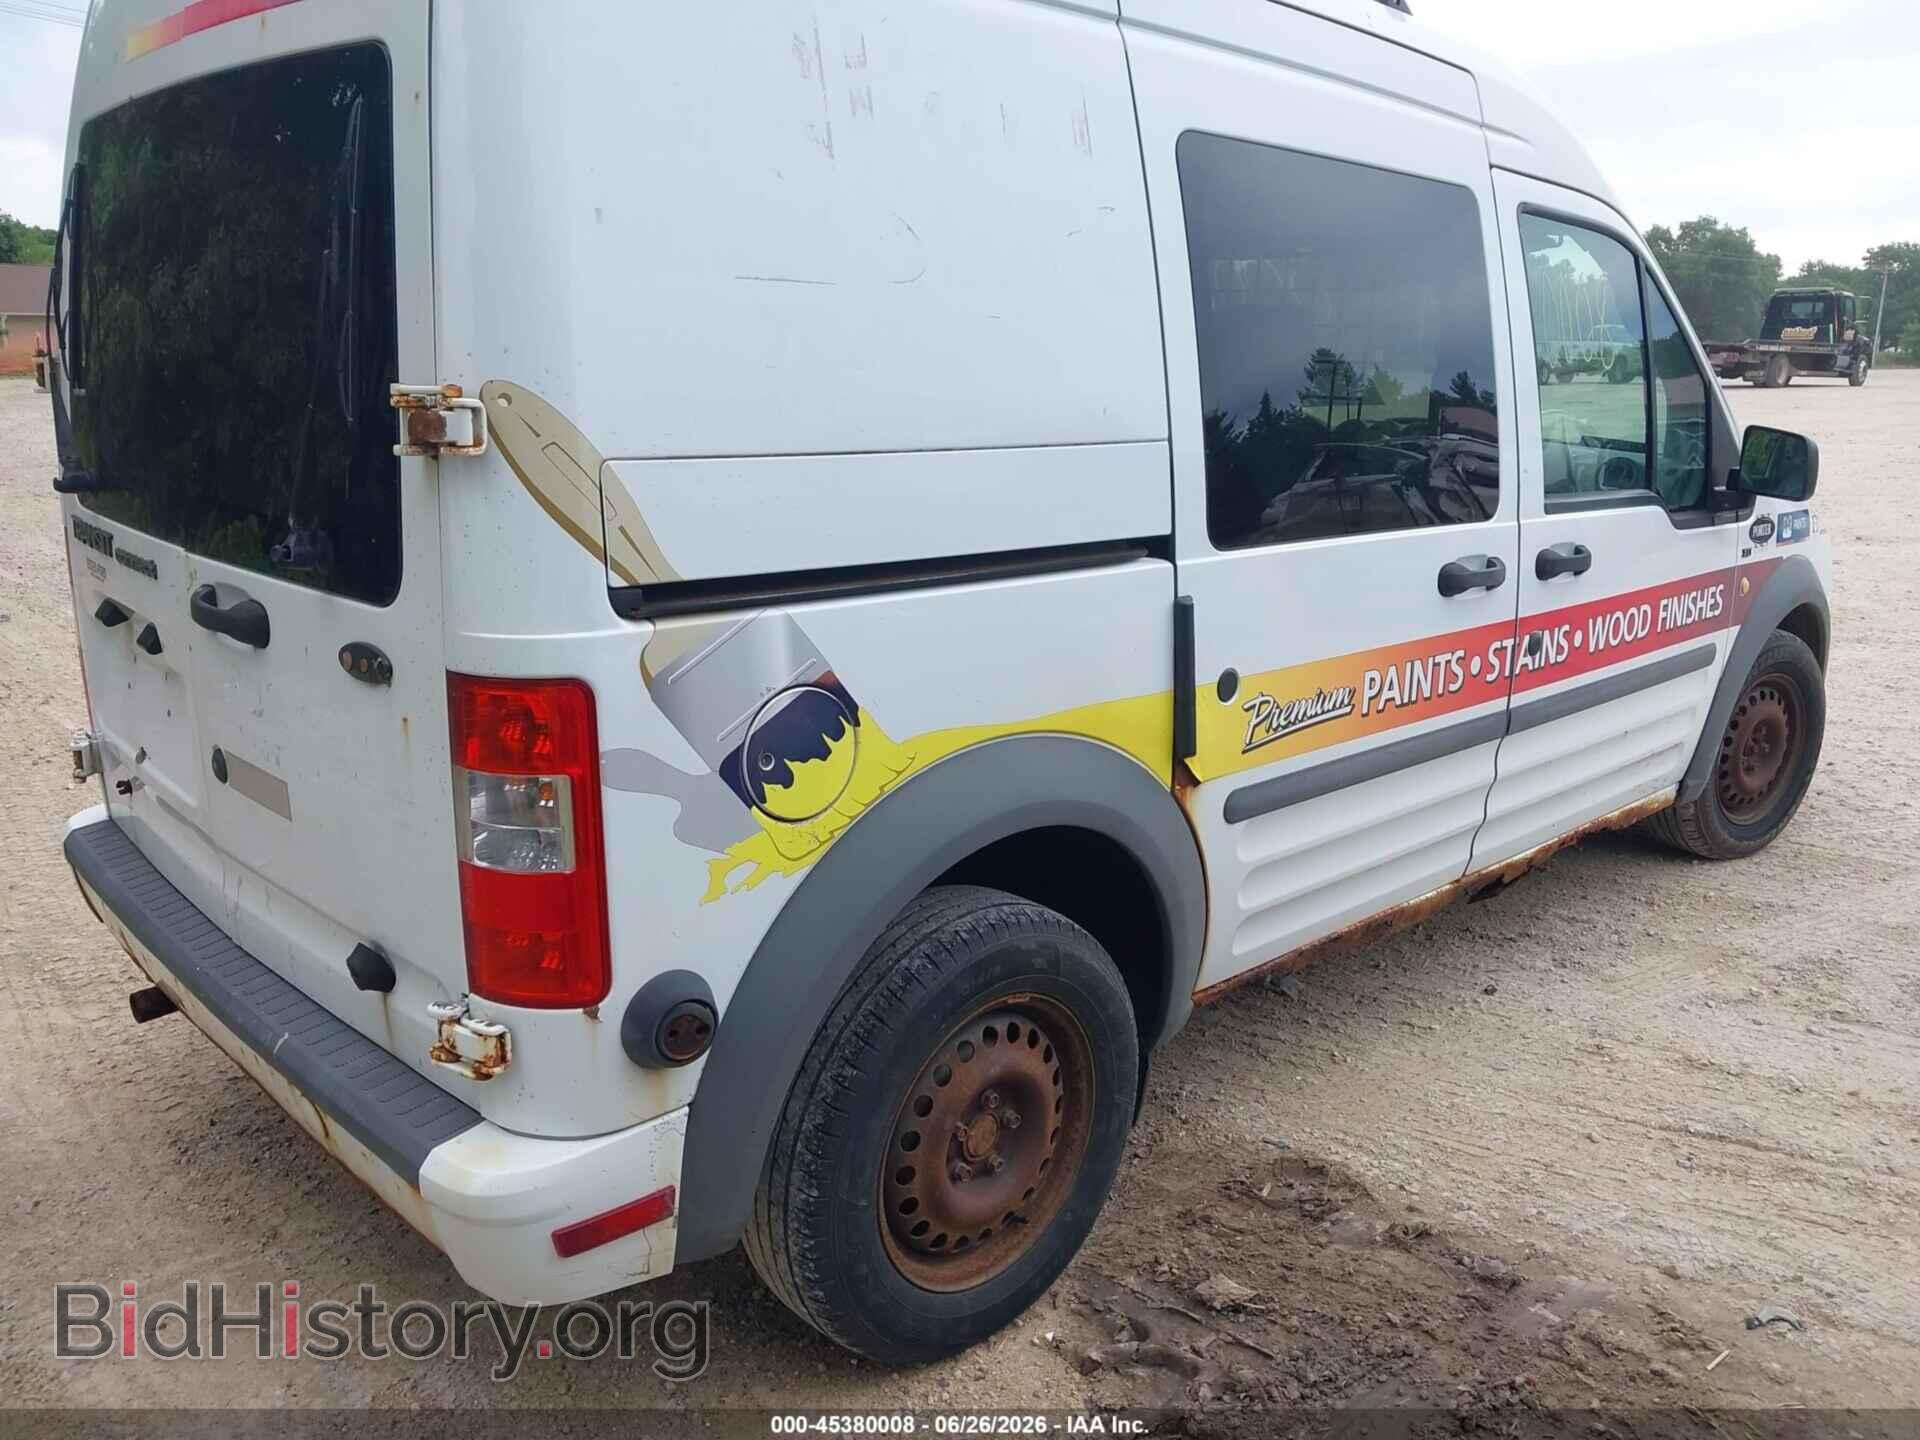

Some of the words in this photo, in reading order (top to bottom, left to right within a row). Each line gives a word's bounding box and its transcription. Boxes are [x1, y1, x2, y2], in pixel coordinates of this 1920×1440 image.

[1242, 687, 1356, 748] Premium
[1362, 649, 1466, 717] PAINTS
[1485, 624, 1570, 683] STAINS
[1588, 604, 1652, 653] WOOD
[1657, 584, 1725, 633] FINISHES
